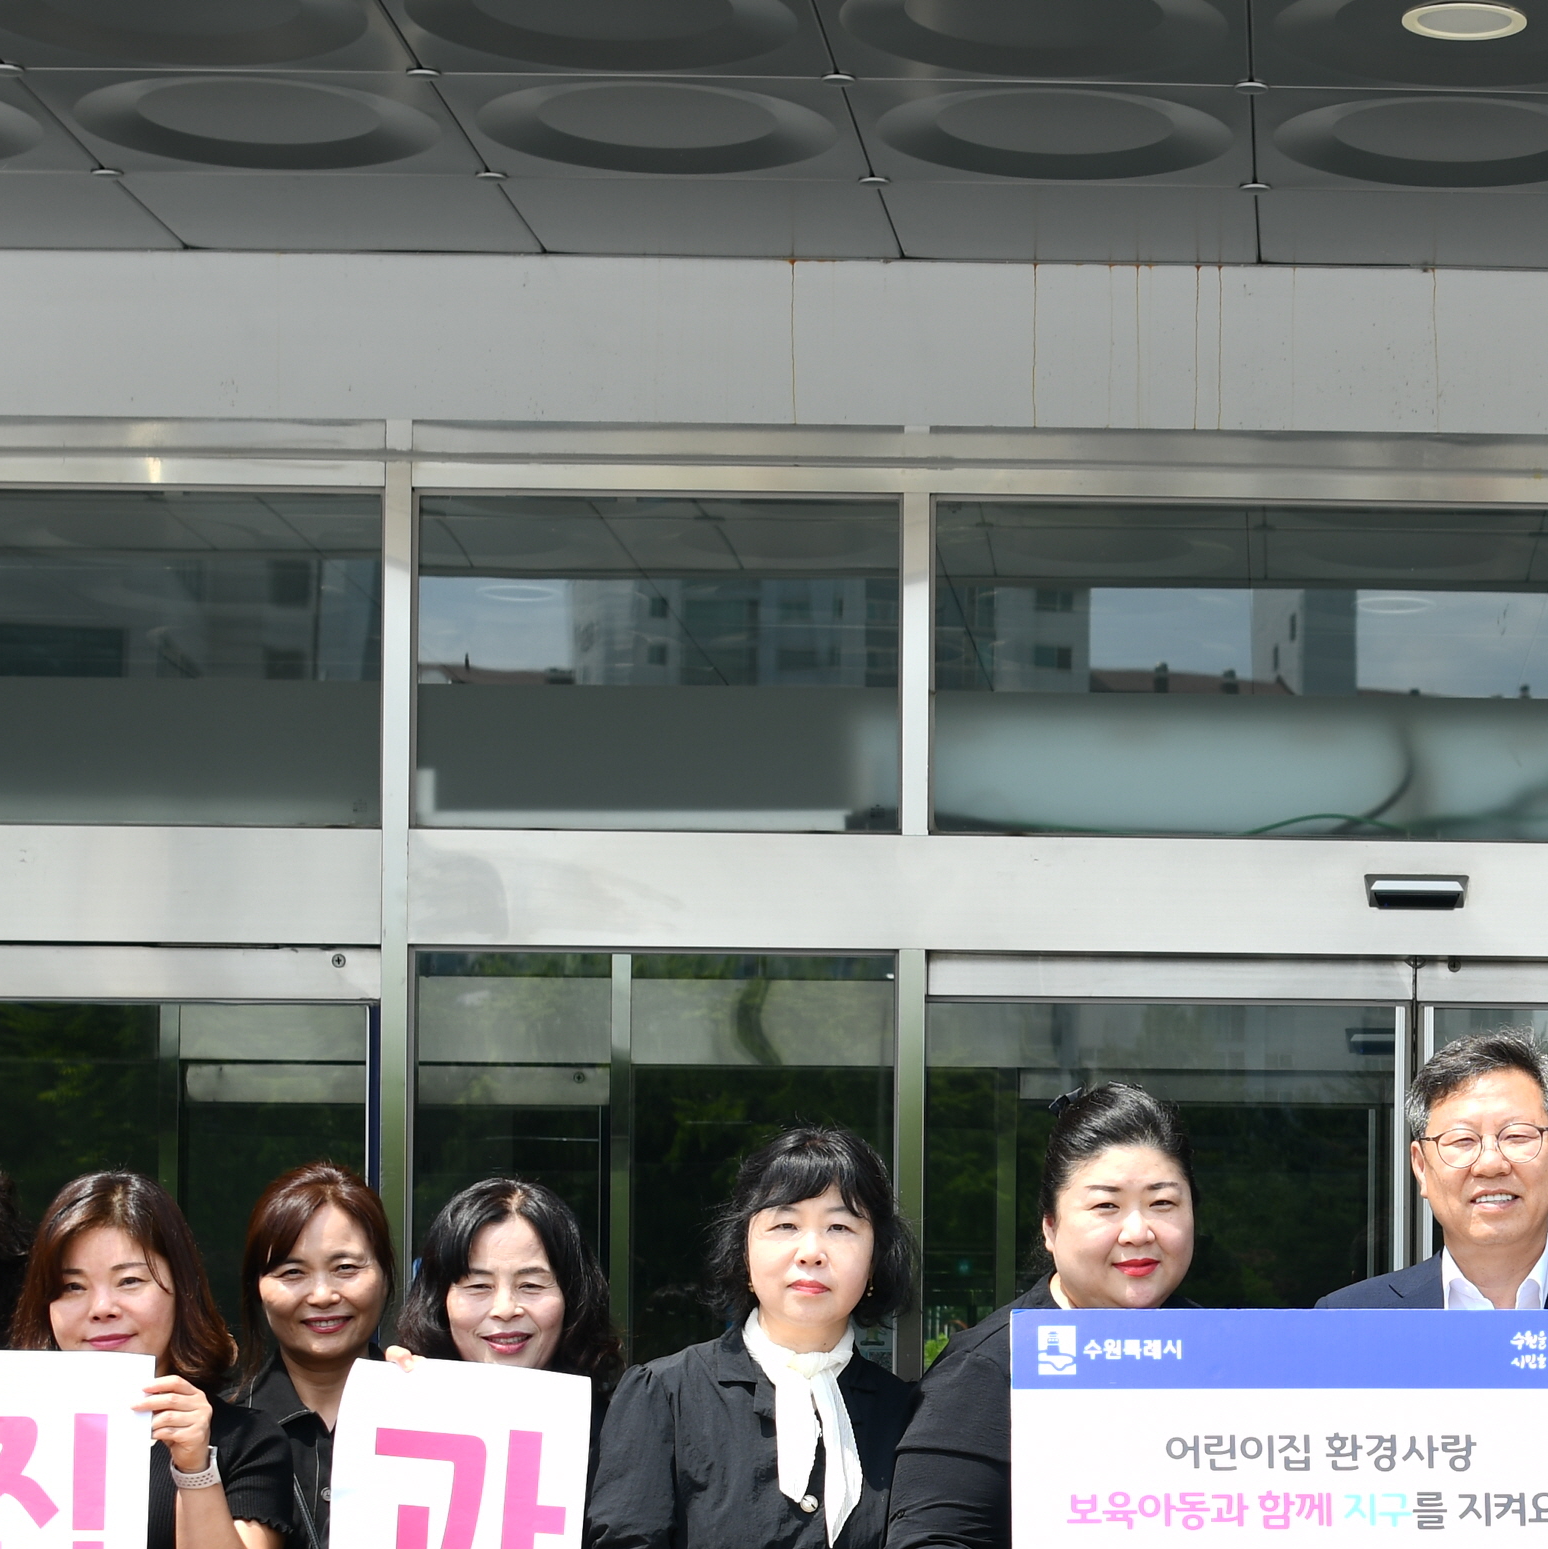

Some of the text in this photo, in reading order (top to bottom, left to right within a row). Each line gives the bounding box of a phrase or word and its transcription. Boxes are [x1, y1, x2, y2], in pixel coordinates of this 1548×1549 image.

[1083, 1338, 1183, 1361] 수원특례시
[1511, 1330, 1547, 1350] 수원을
[1511, 1350, 1548, 1370] 시민을
[1165, 1433, 1478, 1473] 어린이집 환경사랑
[1066, 1491, 1249, 1531] 보육아동과
[1258, 1491, 1333, 1531] 함께
[1343, 1491, 1448, 1531] 지구를
